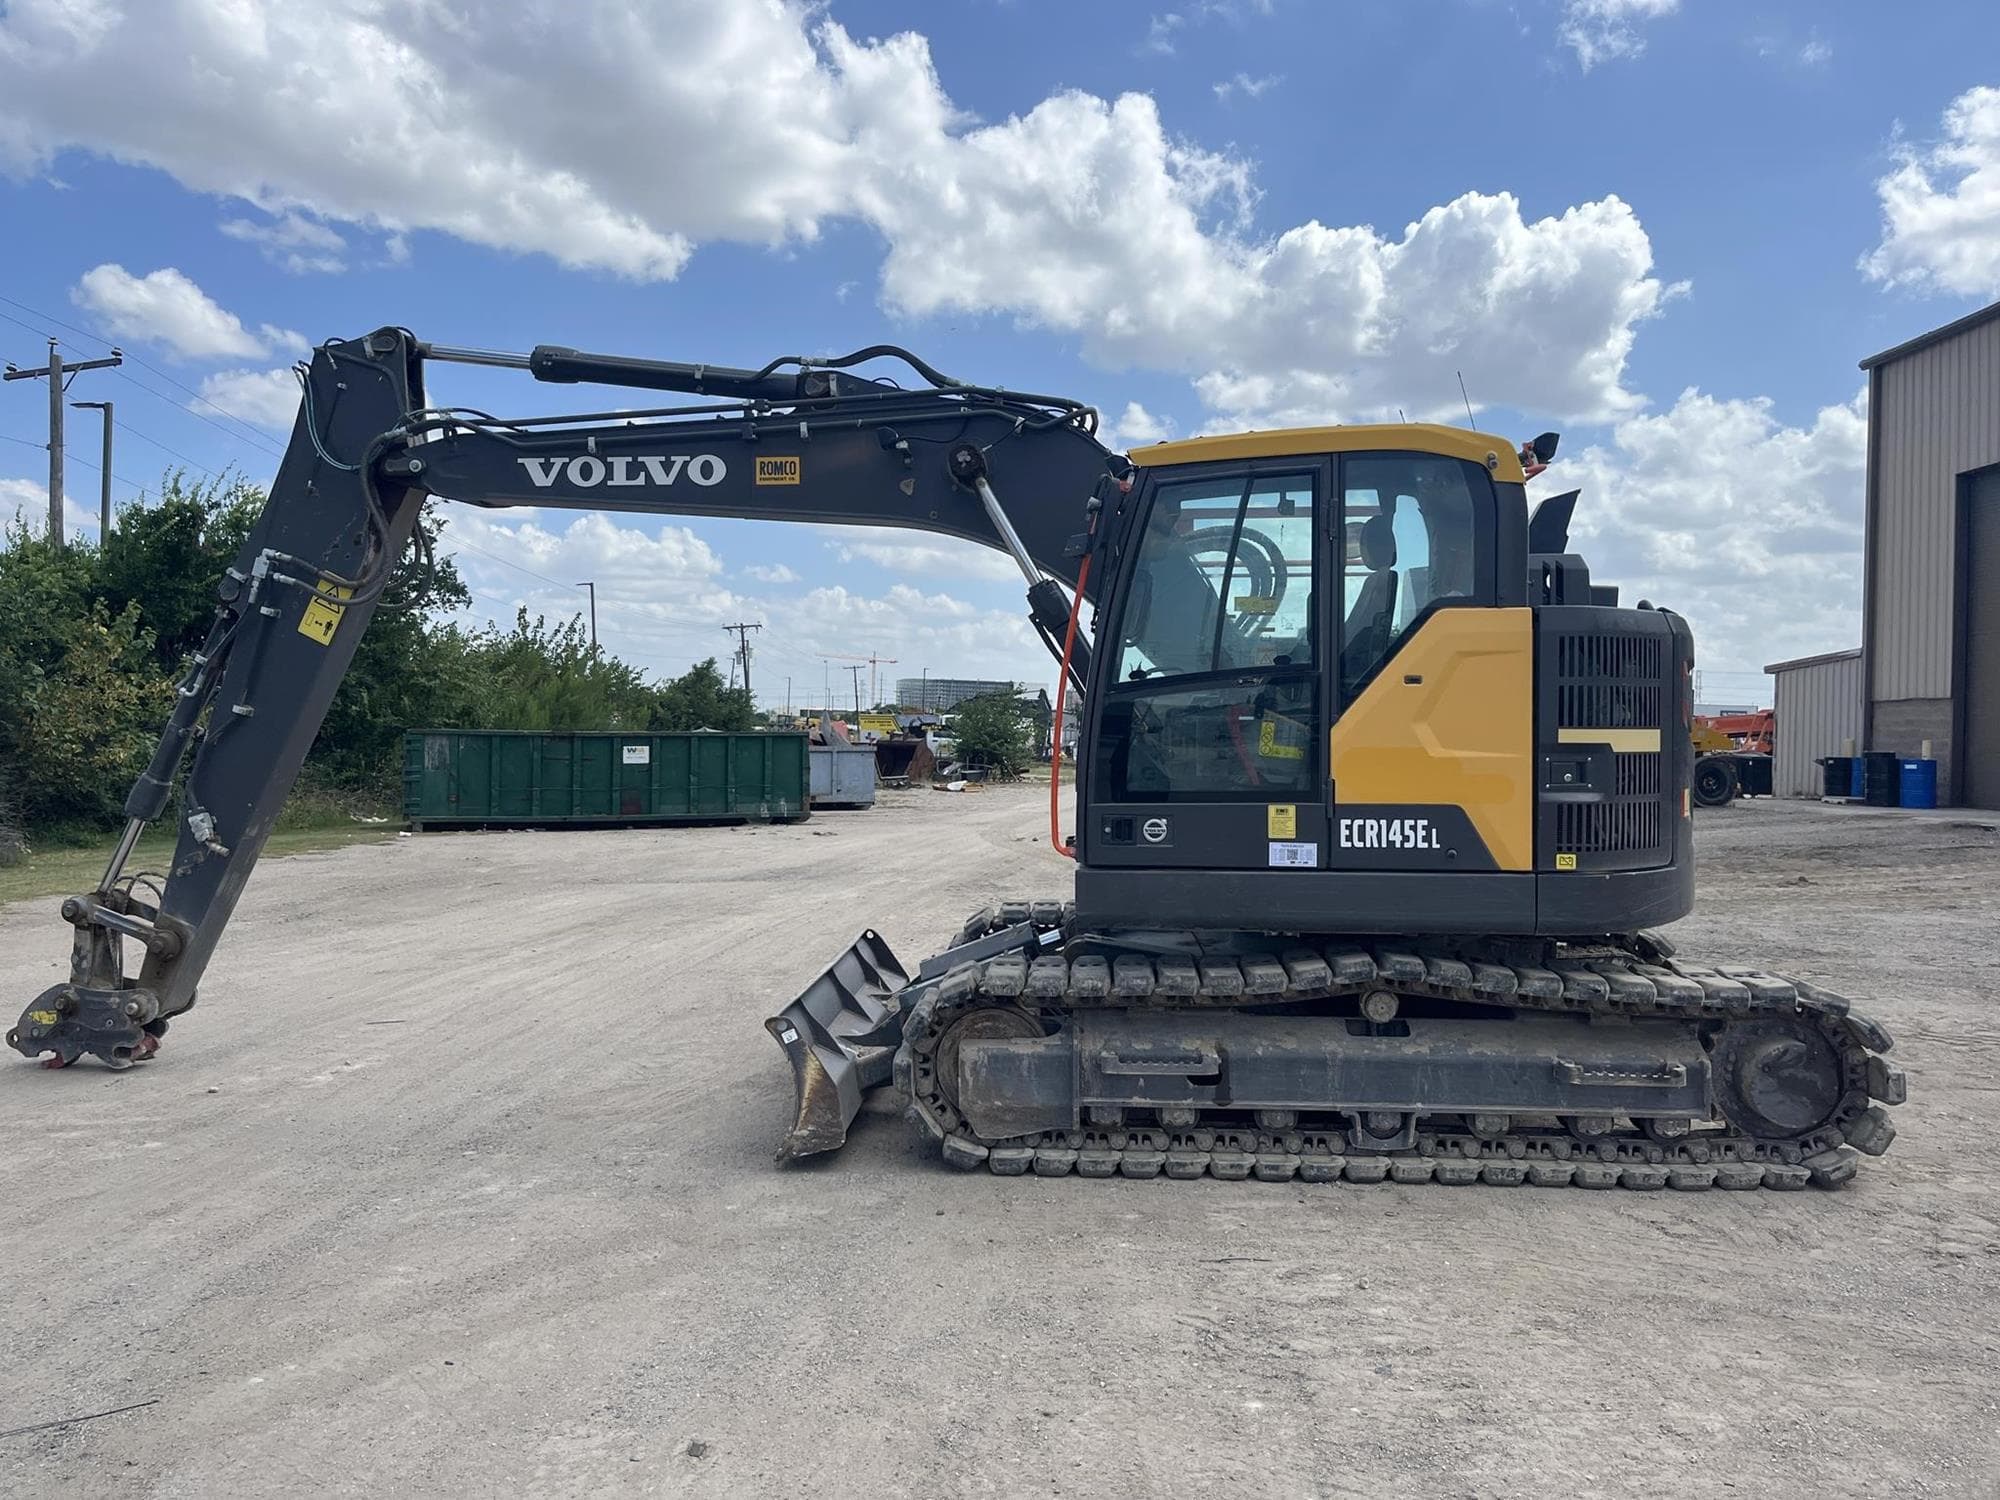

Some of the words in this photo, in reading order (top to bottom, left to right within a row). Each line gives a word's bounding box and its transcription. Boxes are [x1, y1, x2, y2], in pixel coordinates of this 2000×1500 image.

[517, 454, 727, 487] VOLVO
[759, 460, 796, 475] ROMCO
[1340, 819, 1429, 848] ECR145E
